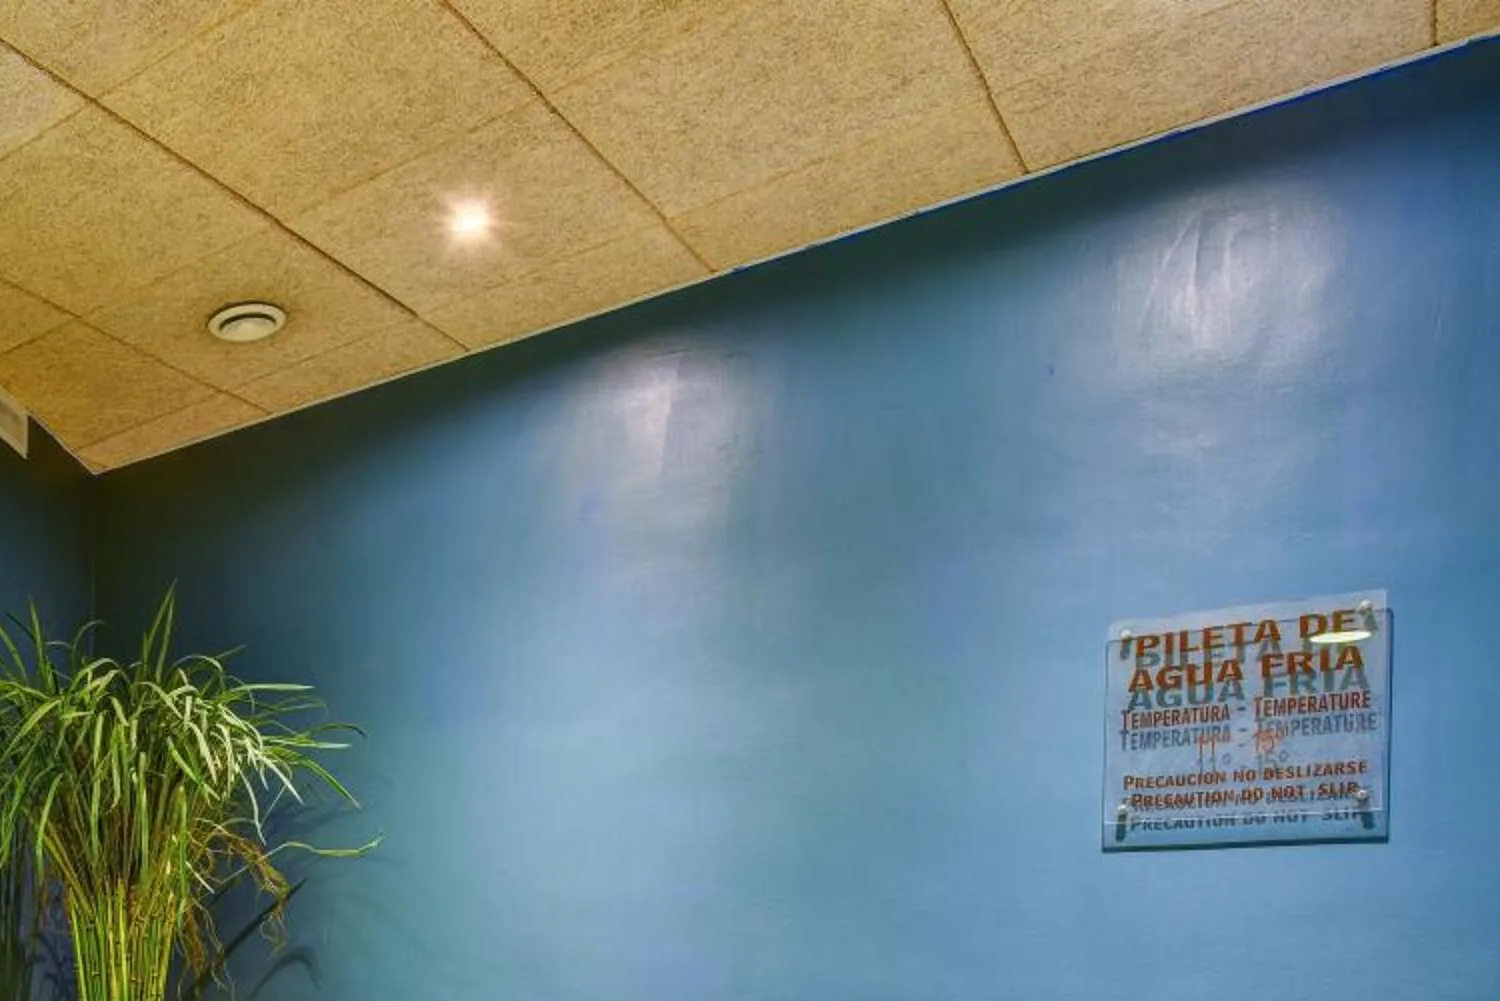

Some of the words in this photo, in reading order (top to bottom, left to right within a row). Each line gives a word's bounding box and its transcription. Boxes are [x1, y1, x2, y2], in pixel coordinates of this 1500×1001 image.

[1135, 619, 1280, 657] PILETA
[1299, 609, 1354, 638] DE
[1128, 659, 1244, 692] AGUA
[1261, 644, 1364, 678] FRIA
[1122, 703, 1231, 730] TEMPERATURA
[1254, 690, 1372, 717] TEMPERATURE
[1232, 768, 1256, 783] NO
[1263, 760, 1368, 781] DESLIZARSE
